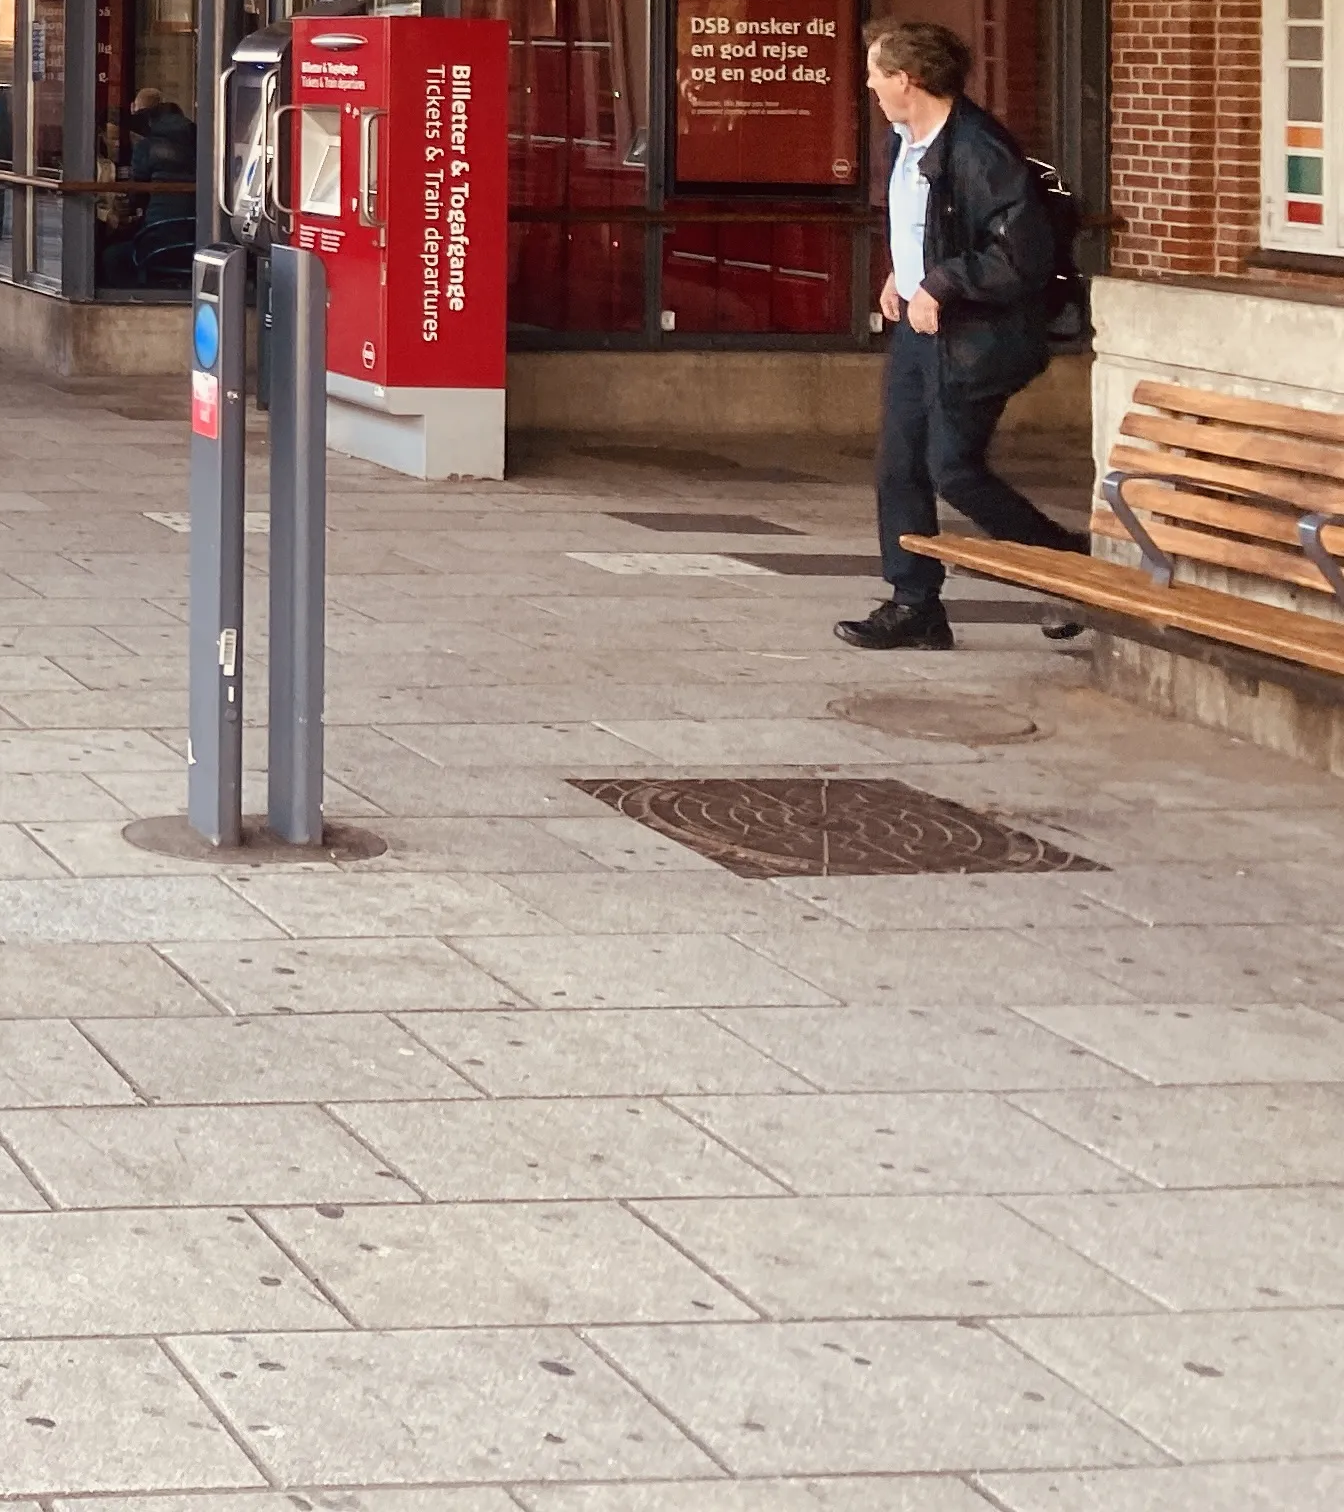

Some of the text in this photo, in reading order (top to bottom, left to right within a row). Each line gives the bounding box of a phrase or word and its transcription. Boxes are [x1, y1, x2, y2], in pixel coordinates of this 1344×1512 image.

[690, 17, 837, 38] DSB ønsker dig
[690, 40, 809, 62] en god rejse
[691, 64, 831, 85] og en god dag.
[446, 65, 472, 312] Billetter & Togafgange
[419, 64, 446, 342] Tickets & Train departures
